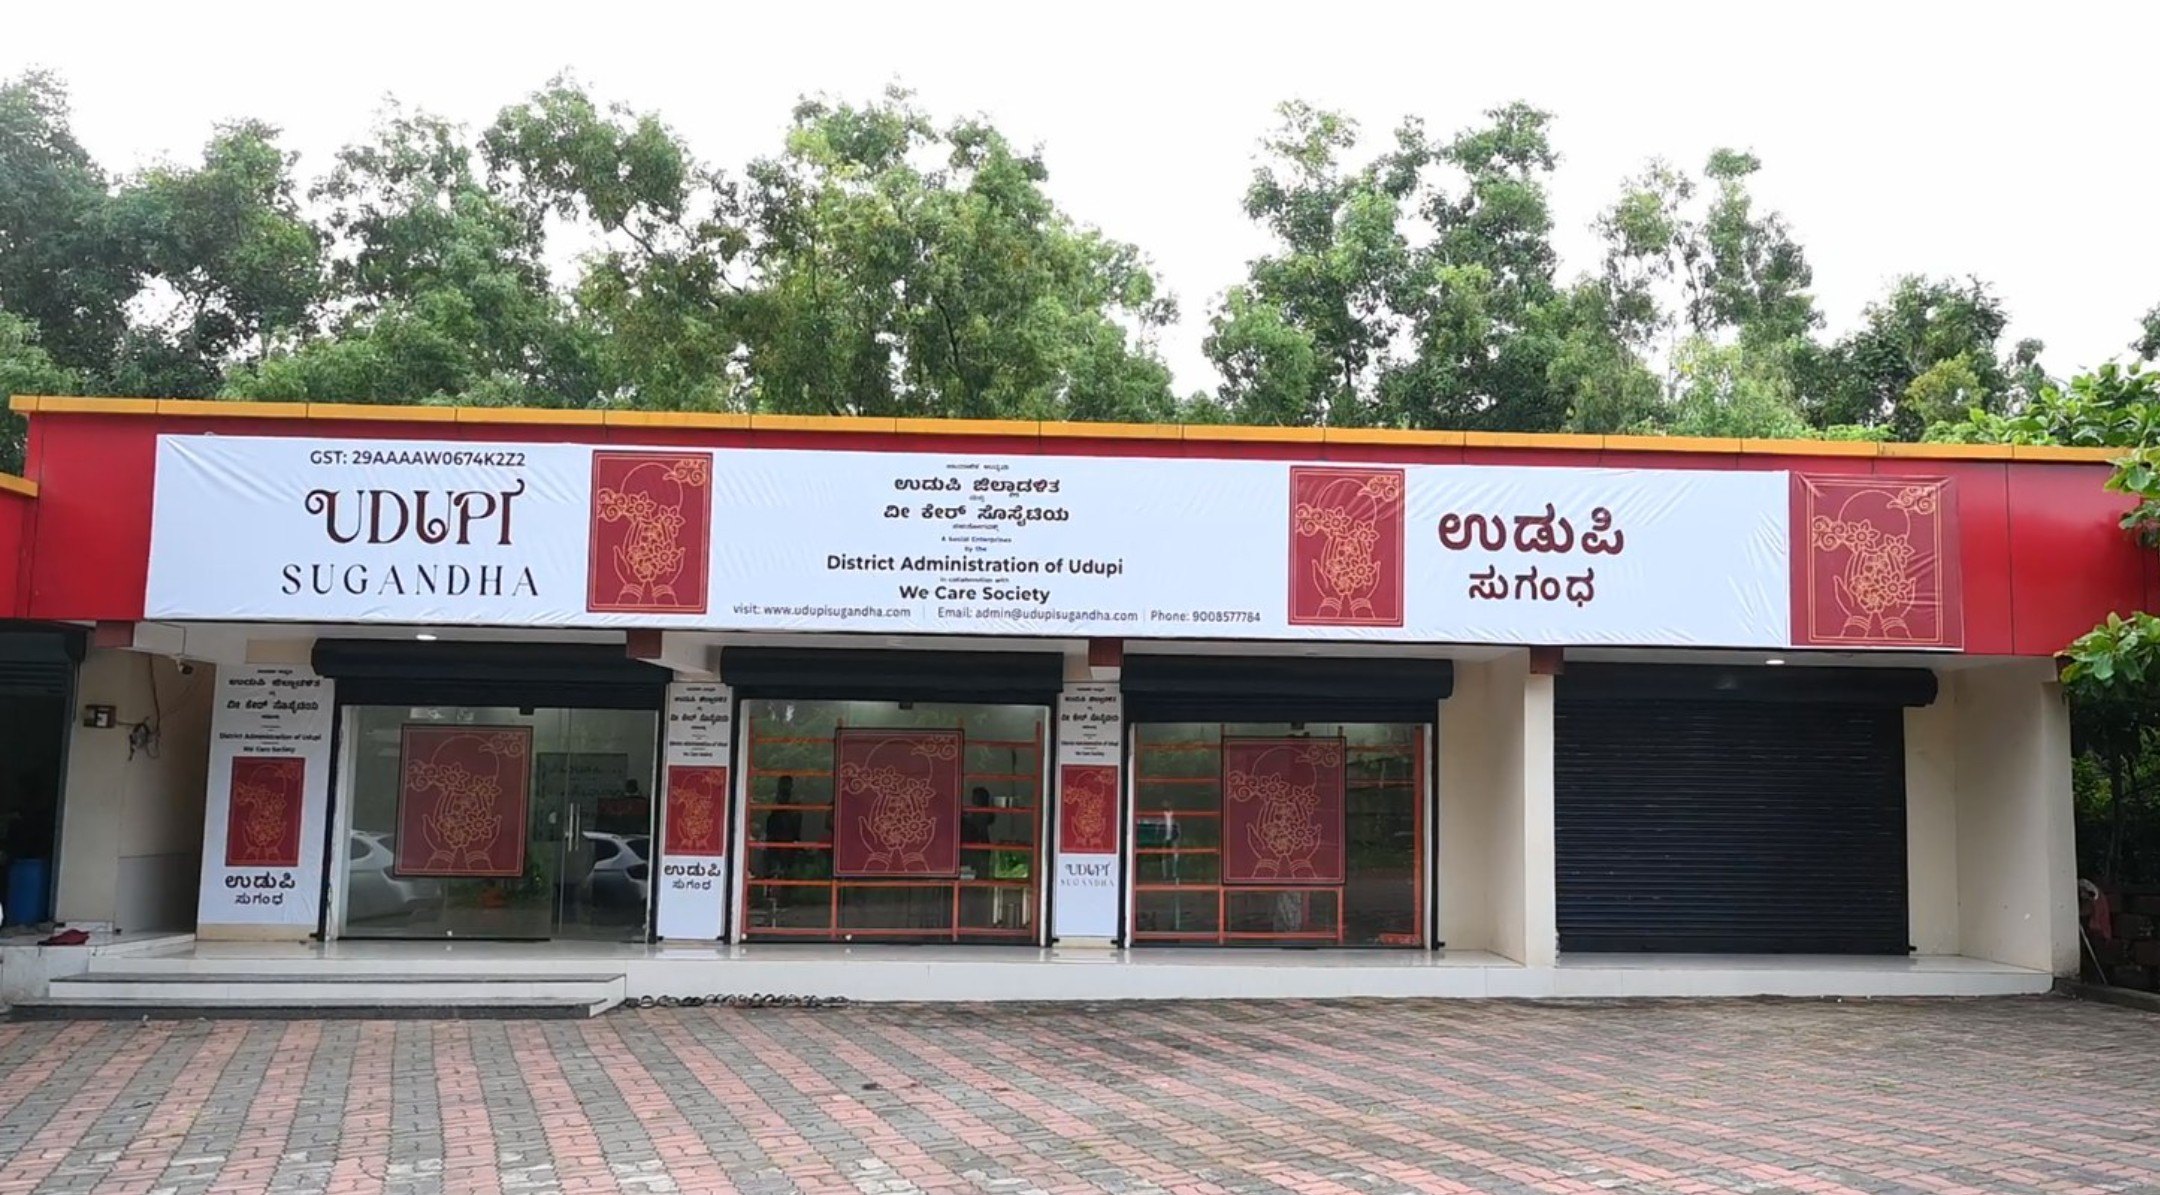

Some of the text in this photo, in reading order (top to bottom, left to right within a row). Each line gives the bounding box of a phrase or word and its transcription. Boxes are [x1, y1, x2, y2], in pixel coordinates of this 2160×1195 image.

[310, 450, 526, 467] GST: 29AAAAW0674K2Z2
[304, 478, 526, 546] UDUPI
[1437, 503, 1625, 555] ಉಡುಪಿ
[827, 553, 1124, 578] District Administration of Udupi
[281, 563, 540, 597] SUGANDHA
[1468, 565, 1596, 608] ಸುಗಂಧ
[899, 585, 1051, 605] We Care Society
[764, 606, 911, 620] www.udupisugandha.com
[937, 606, 1138, 624] Email: admin@udupisugandha.com
[1150, 610, 1188, 622] Phone:
[664, 861, 721, 877] ಉಡುಪಿ
[224, 871, 296, 889] ಉಡುಪಿ
[235, 892, 284, 906] ಸುಗಂಧ
